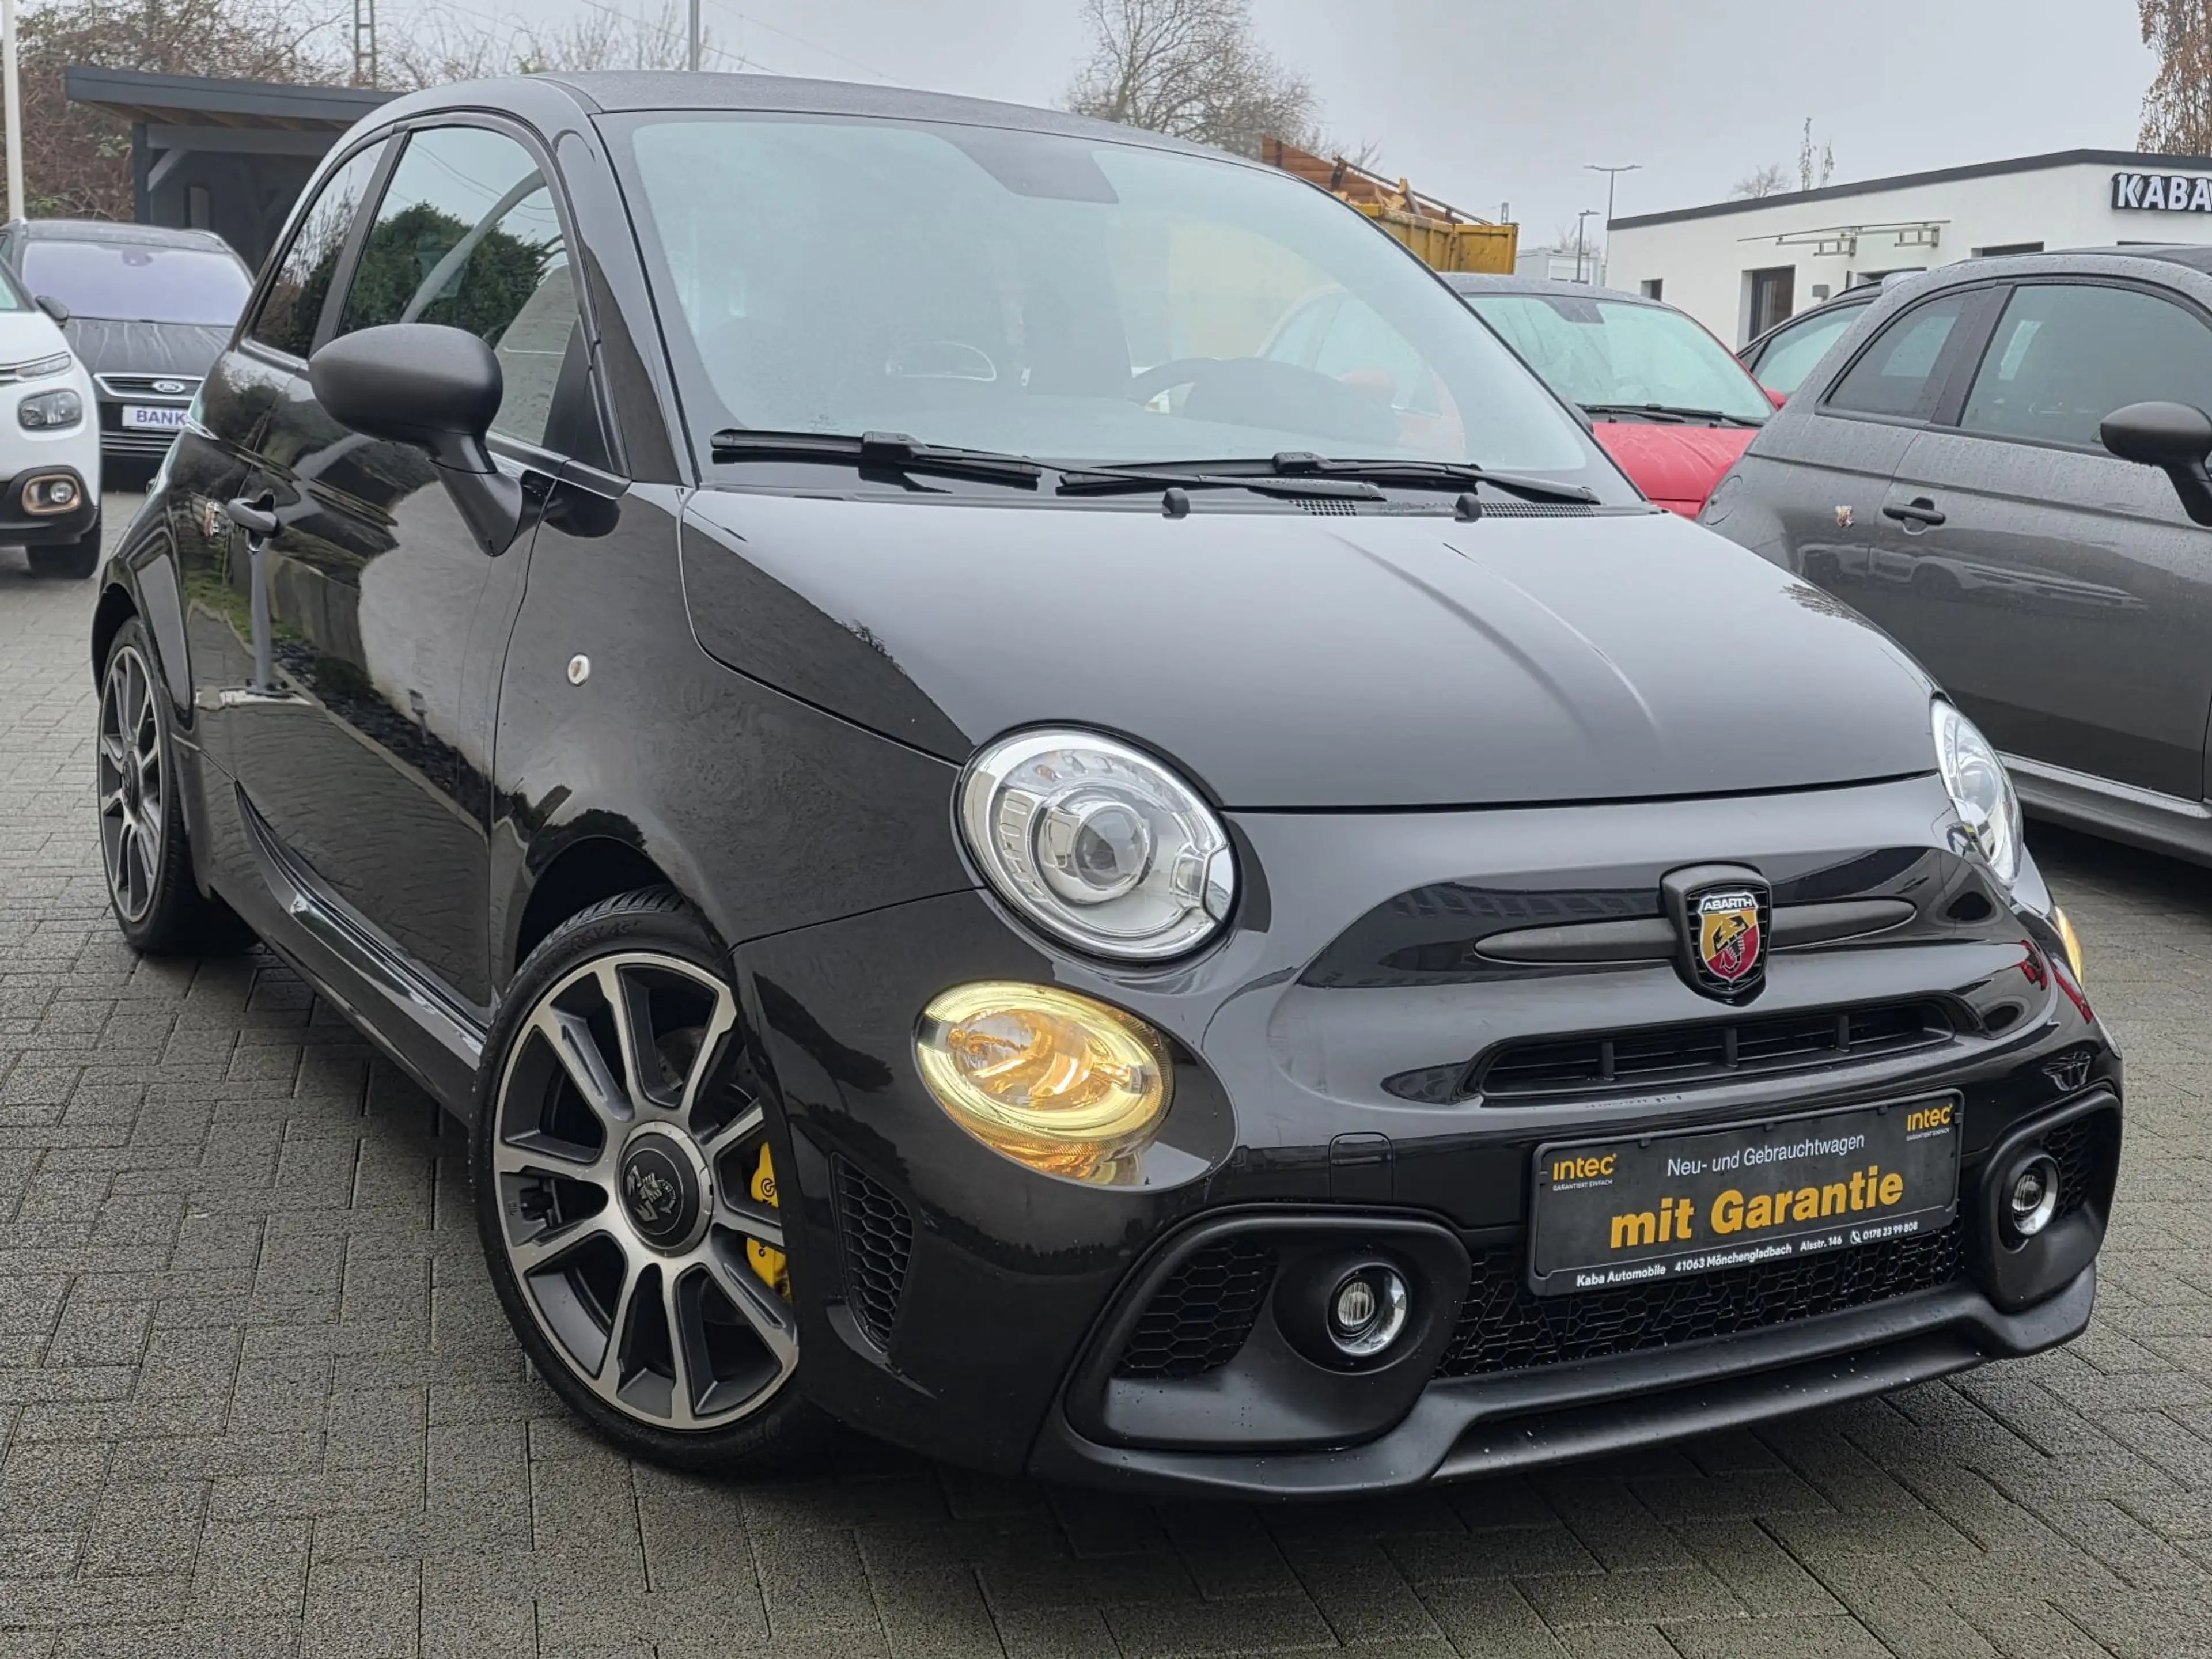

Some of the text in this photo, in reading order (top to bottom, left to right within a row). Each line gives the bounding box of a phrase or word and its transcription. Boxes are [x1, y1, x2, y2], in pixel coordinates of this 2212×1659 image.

[2117, 174, 2212, 212] KABA
[135, 410, 187, 425] BANK
[1704, 898, 1752, 910] ABARTH
[1667, 1134, 1865, 1176] Neu- und Gebrauchtwagen
[1611, 1165, 1903, 1248] mit Garantie
[1800, 1235, 1843, 1252] Alsstr. 146
[1863, 1227, 1882, 1240] 0178
[1883, 1226, 1892, 1236] 23
[1893, 1224, 1903, 1234] 99
[1674, 1244, 1792, 1272] 41063 Mönchengladbach
[1576, 1264, 1666, 1287] Kaba Automobile
